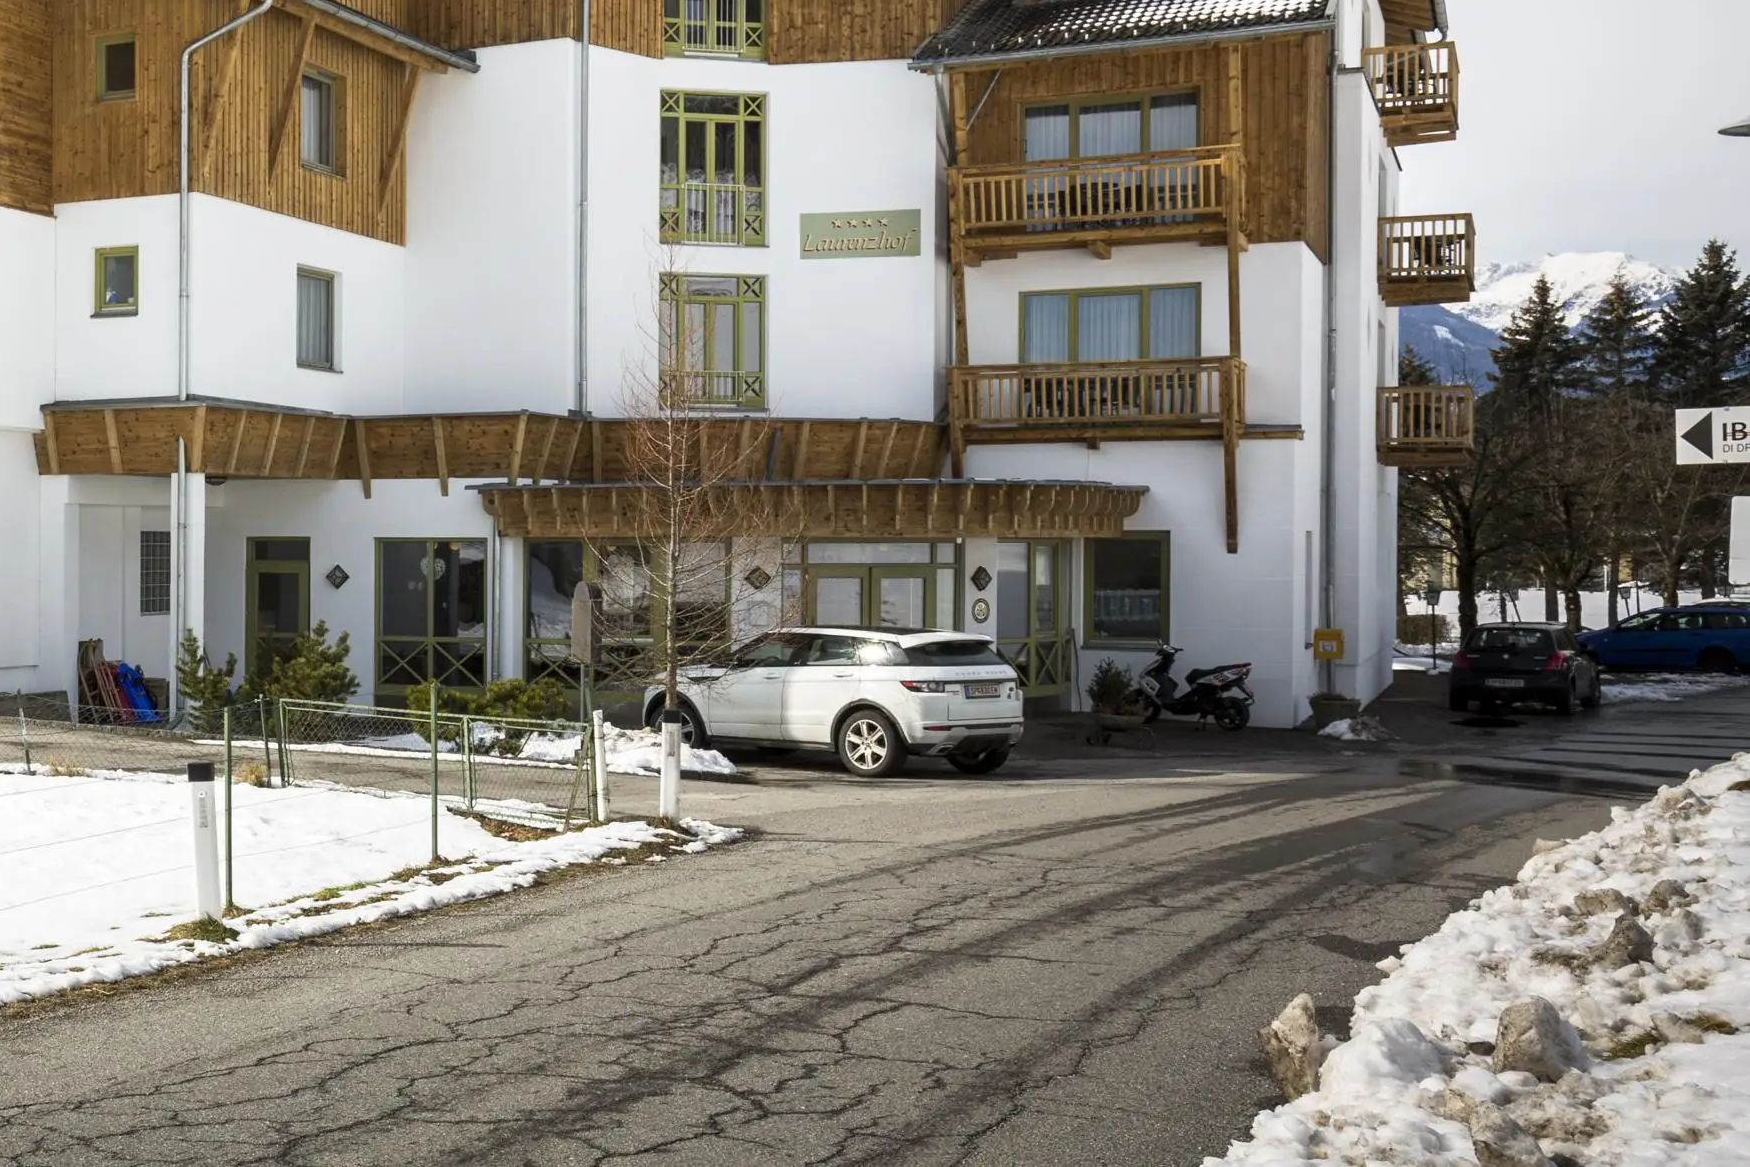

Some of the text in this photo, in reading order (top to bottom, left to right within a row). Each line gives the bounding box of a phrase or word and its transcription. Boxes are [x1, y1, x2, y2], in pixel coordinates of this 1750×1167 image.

[802, 228, 918, 252] Laurenzhof
[1722, 422, 1748, 441] IB
[1723, 444, 1733, 453] DI
